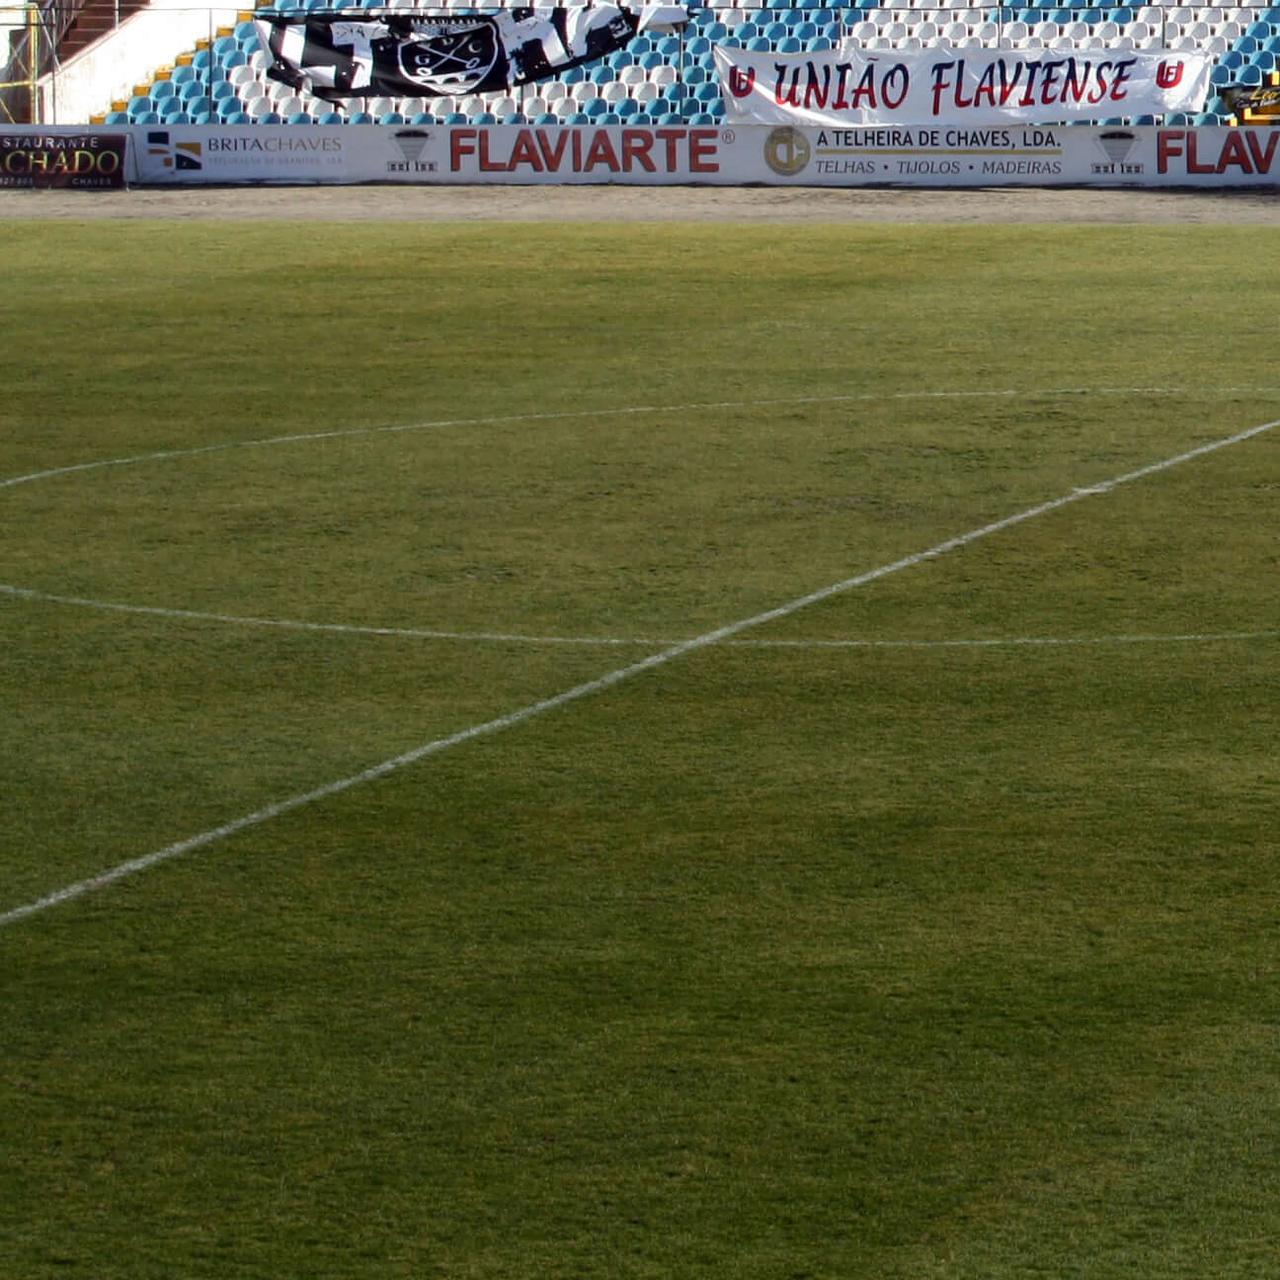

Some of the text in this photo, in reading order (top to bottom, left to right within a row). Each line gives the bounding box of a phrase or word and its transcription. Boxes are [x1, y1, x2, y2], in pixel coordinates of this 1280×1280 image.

[774, 56, 1138, 116] UNIÃO FLAVIENSE
[208, 136, 342, 152] BRITACHAVES
[450, 128, 720, 173] FLAVIARTE
[817, 130, 1062, 150] A TELHEIRA DE CHAVES, LDA.
[0, 149, 119, 175] CHADO
[816, 160, 1062, 175] TELHAS TIJOLOS MADEIRAS
